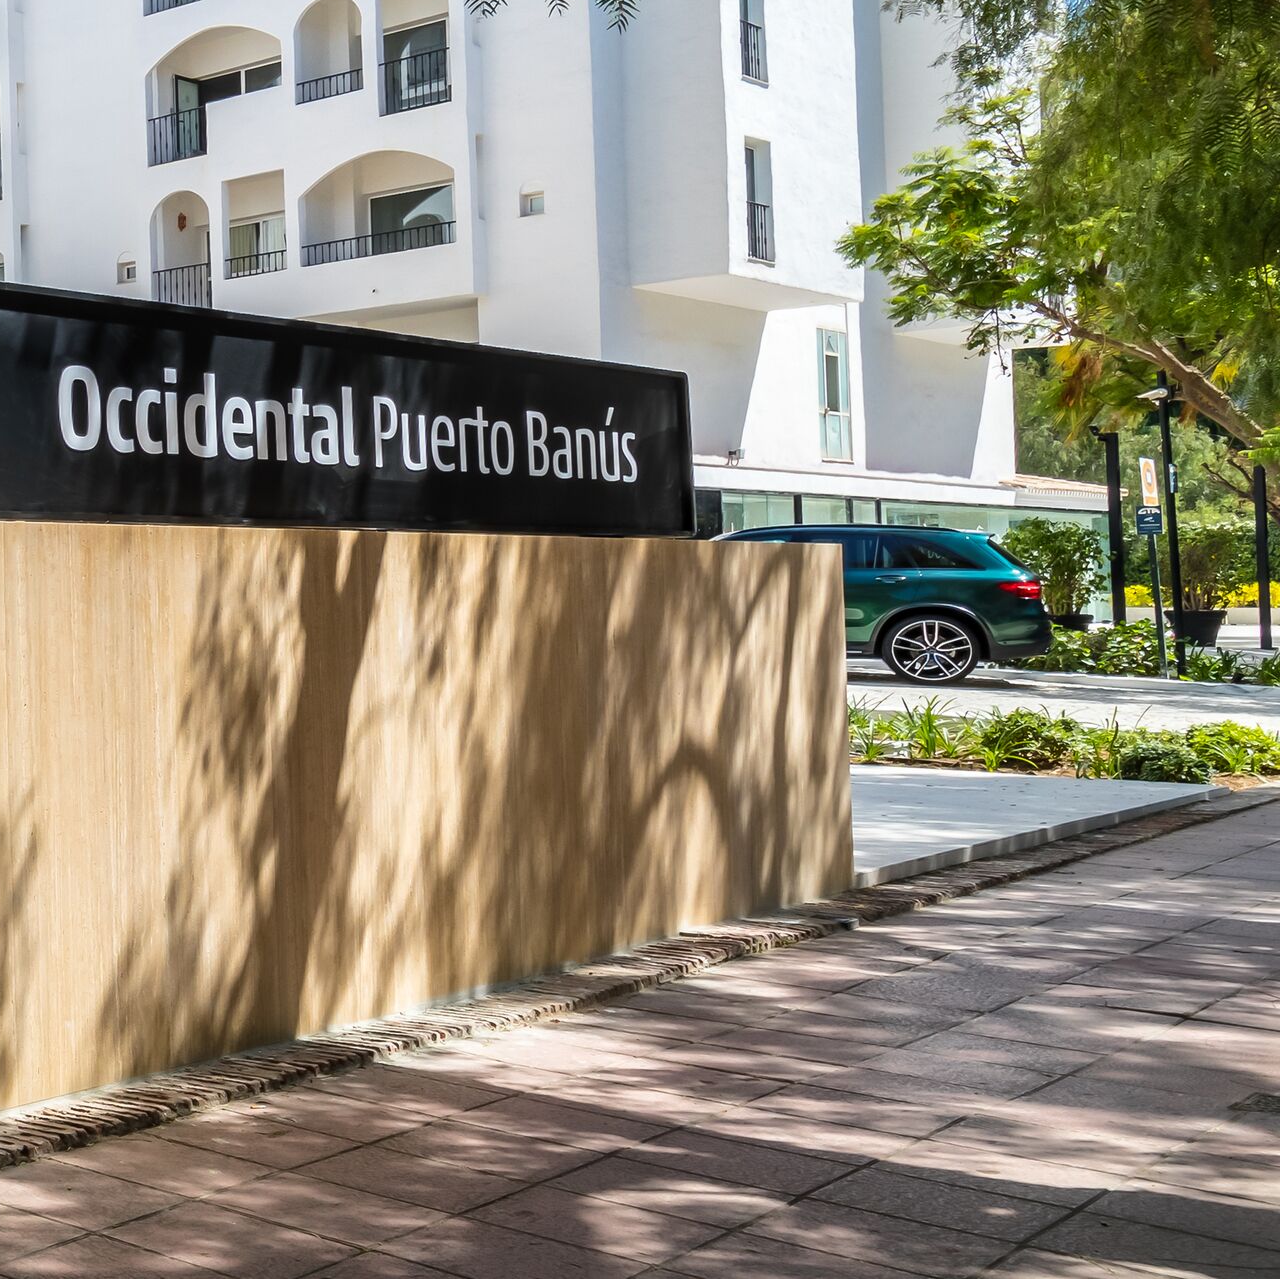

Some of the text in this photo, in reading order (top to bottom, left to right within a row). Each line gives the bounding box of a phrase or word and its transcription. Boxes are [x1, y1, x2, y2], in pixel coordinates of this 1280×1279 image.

[57, 365, 639, 483] Occidental Puerto Banús
